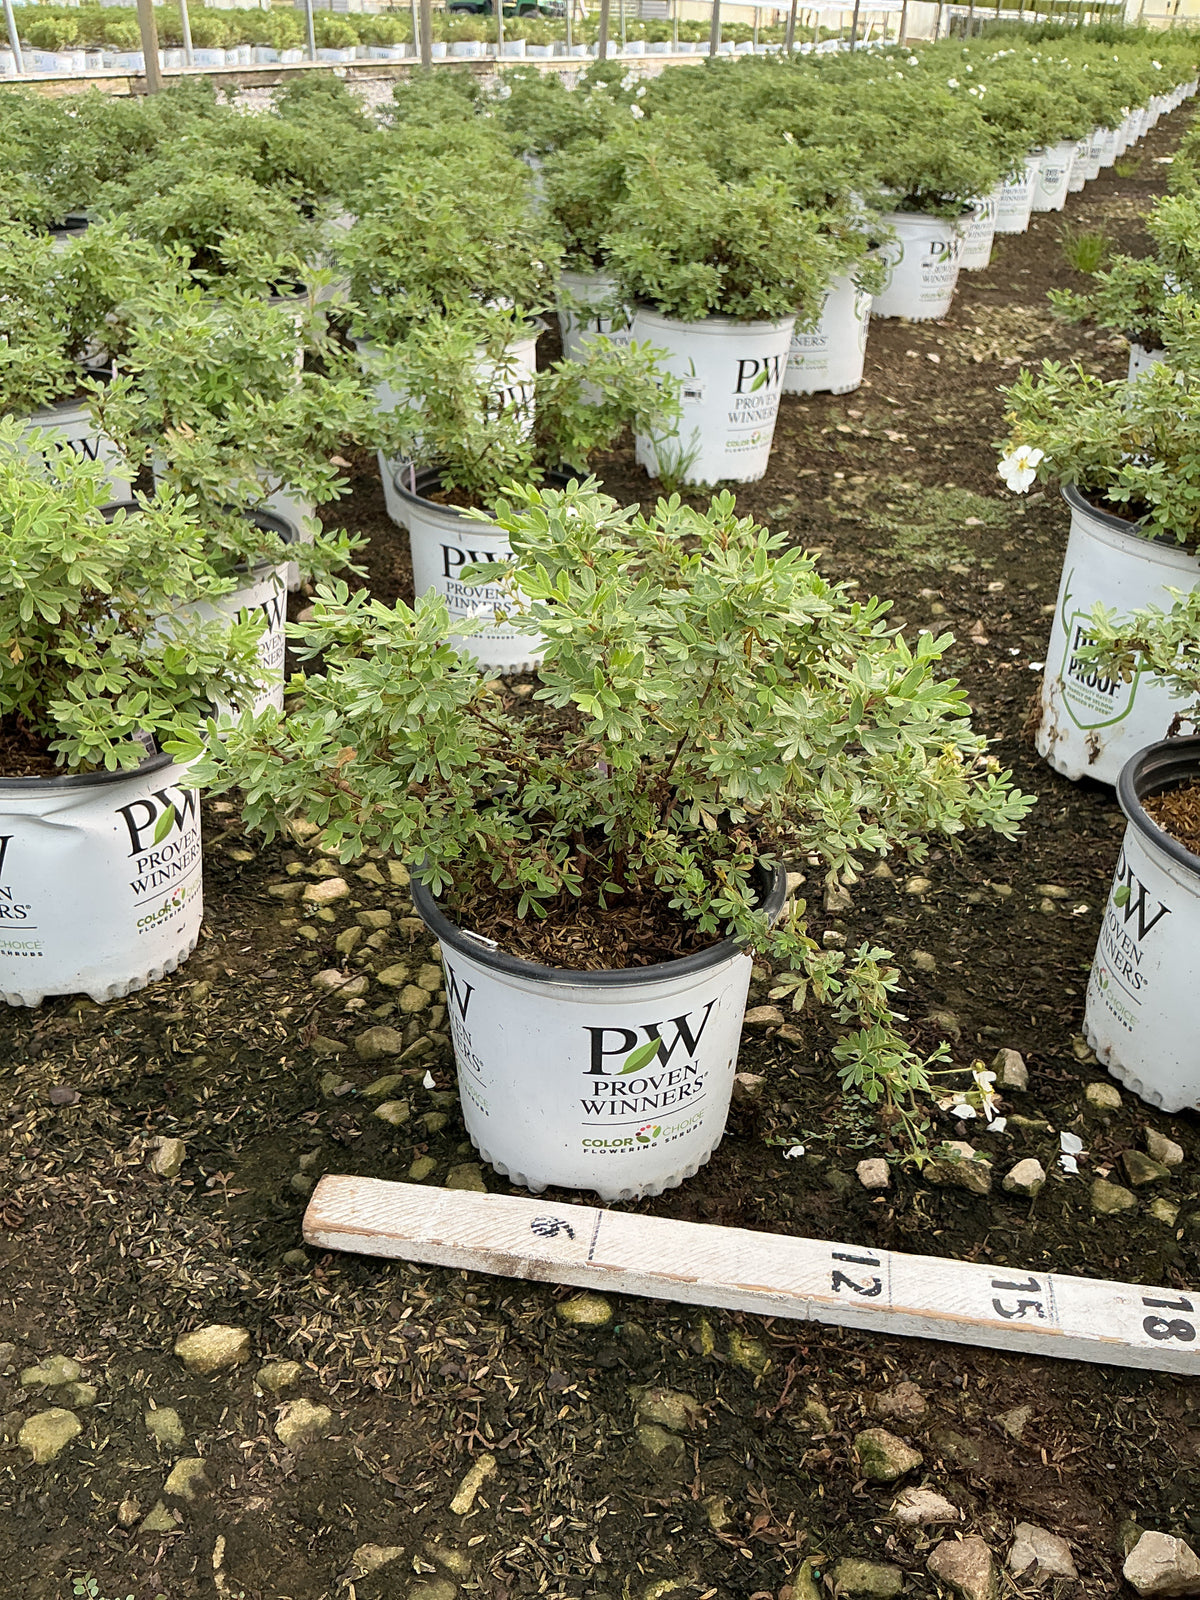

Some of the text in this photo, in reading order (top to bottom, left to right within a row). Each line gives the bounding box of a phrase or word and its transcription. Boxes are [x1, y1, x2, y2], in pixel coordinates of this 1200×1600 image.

[732, 355, 780, 394] PW
[445, 594, 512, 613] WINNRS
[446, 581, 506, 600] PROVEN
[114, 782, 200, 857] PW
[136, 828, 198, 875] PROVEN
[137, 903, 172, 928] COLOR
[581, 998, 718, 1075] PW
[592, 1060, 700, 1097] PROVEN
[582, 1109, 704, 1148] COLOR CHOICE
[583, 1119, 703, 1155] FLOWERING SHRUBS
[831, 1252, 882, 1297] 12
[991, 1276, 1048, 1319] 15
[1142, 1297, 1197, 1342] 18
